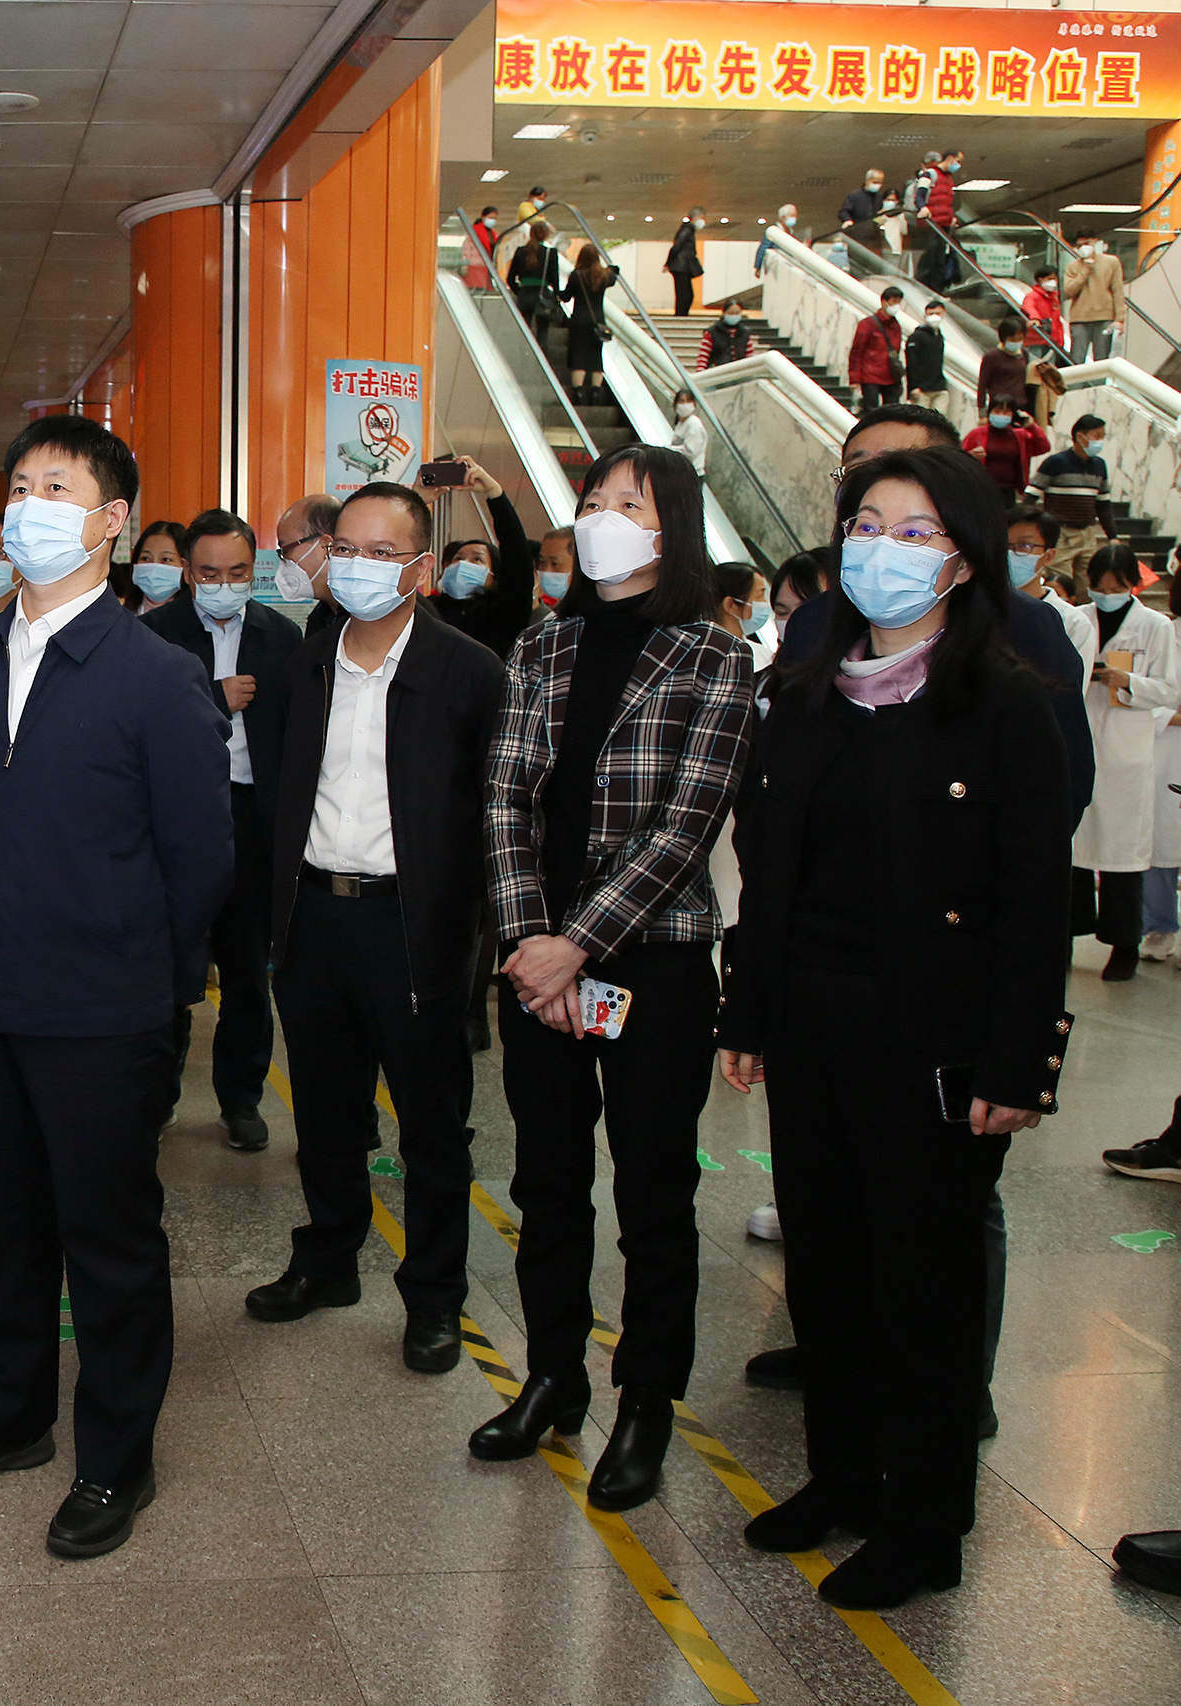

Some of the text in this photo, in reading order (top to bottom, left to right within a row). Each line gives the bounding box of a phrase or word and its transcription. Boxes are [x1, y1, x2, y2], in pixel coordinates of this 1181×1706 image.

[495, 35, 1140, 107] 康放在优先发展的战略位置
[331, 367, 419, 402] 打击骗保
